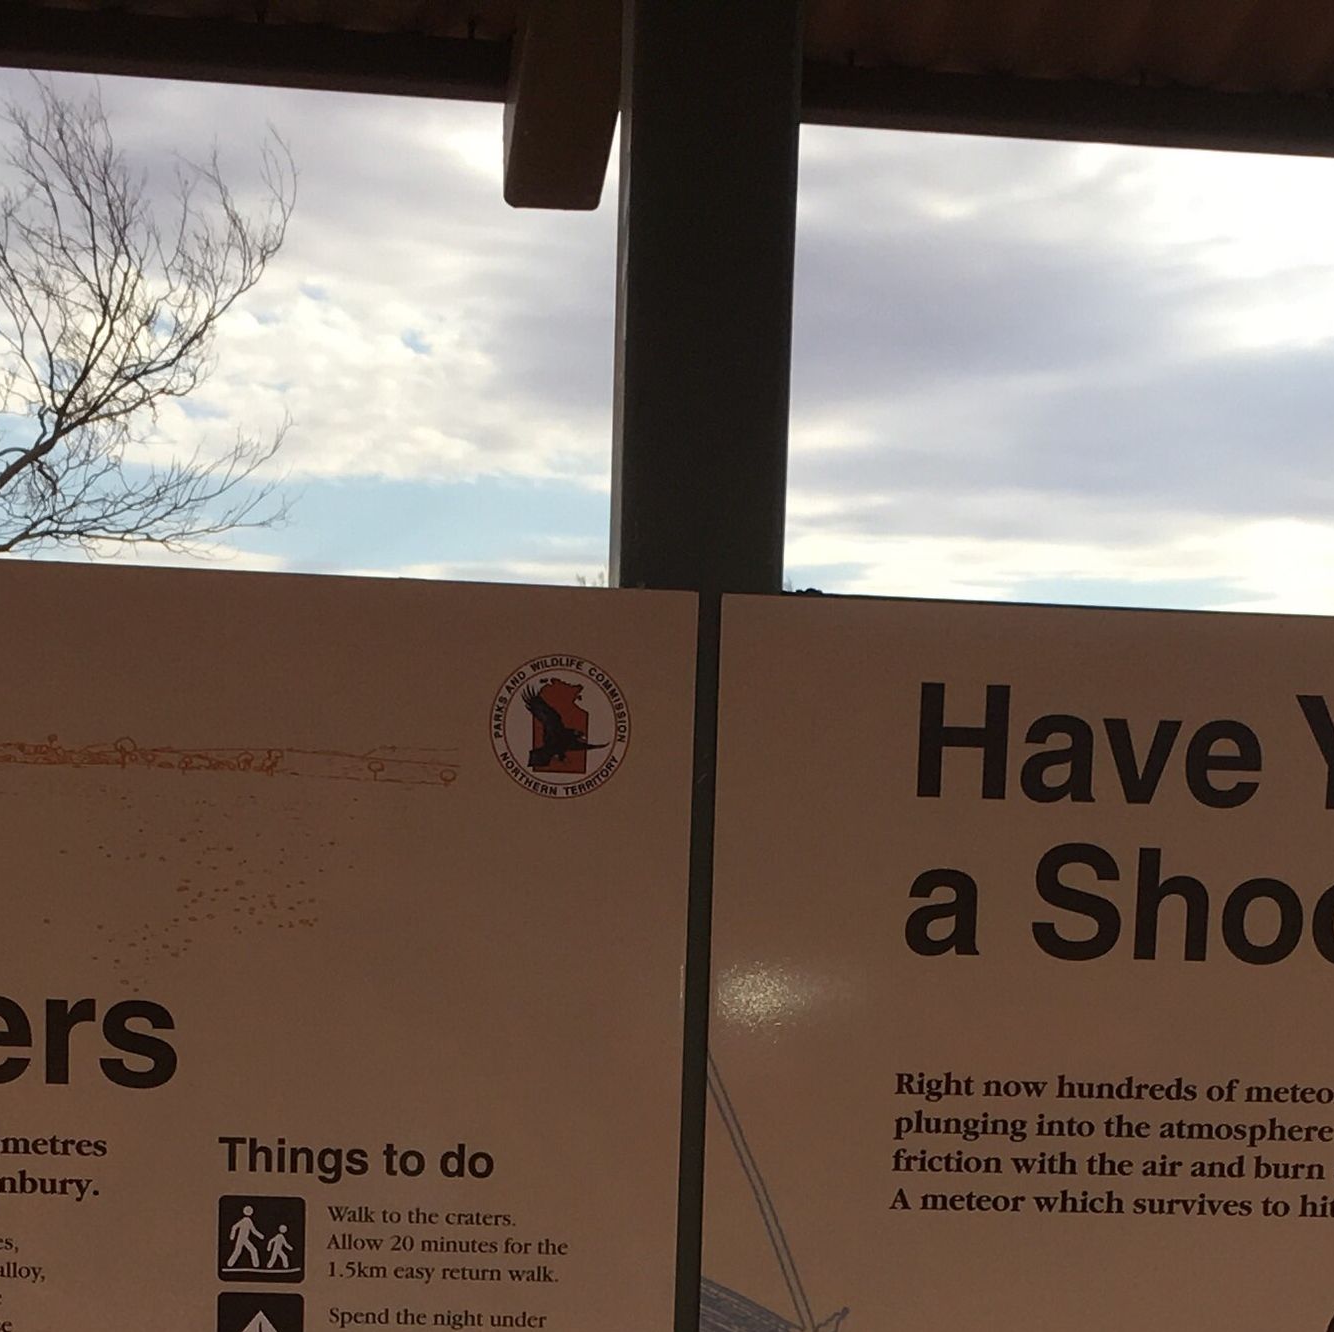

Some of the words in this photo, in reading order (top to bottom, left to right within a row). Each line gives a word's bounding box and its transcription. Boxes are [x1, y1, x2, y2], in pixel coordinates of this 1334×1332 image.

[494, 695, 508, 739] PARKS
[506, 671, 527, 695] AND
[530, 657, 585, 673] WILDLIFE
[588, 667, 628, 743] COMMISSION
[916, 681, 1263, 809] Have
[500, 752, 558, 796] NORTHERN
[563, 755, 619, 796] TERRITORY
[904, 868, 980, 957] a
[895, 1071, 974, 1103] Right
[983, 1080, 1048, 1098] now
[1056, 1074, 1198, 1102] hundreds
[1206, 1078, 1240, 1102] of
[218, 1136, 369, 1185] Things
[382, 1143, 426, 1177] to
[439, 1143, 494, 1179] do
[327, 1205, 375, 1223] Walk
[381, 1209, 402, 1224] to
[407, 1207, 439, 1225] the
[445, 1212, 517, 1226] craters.
